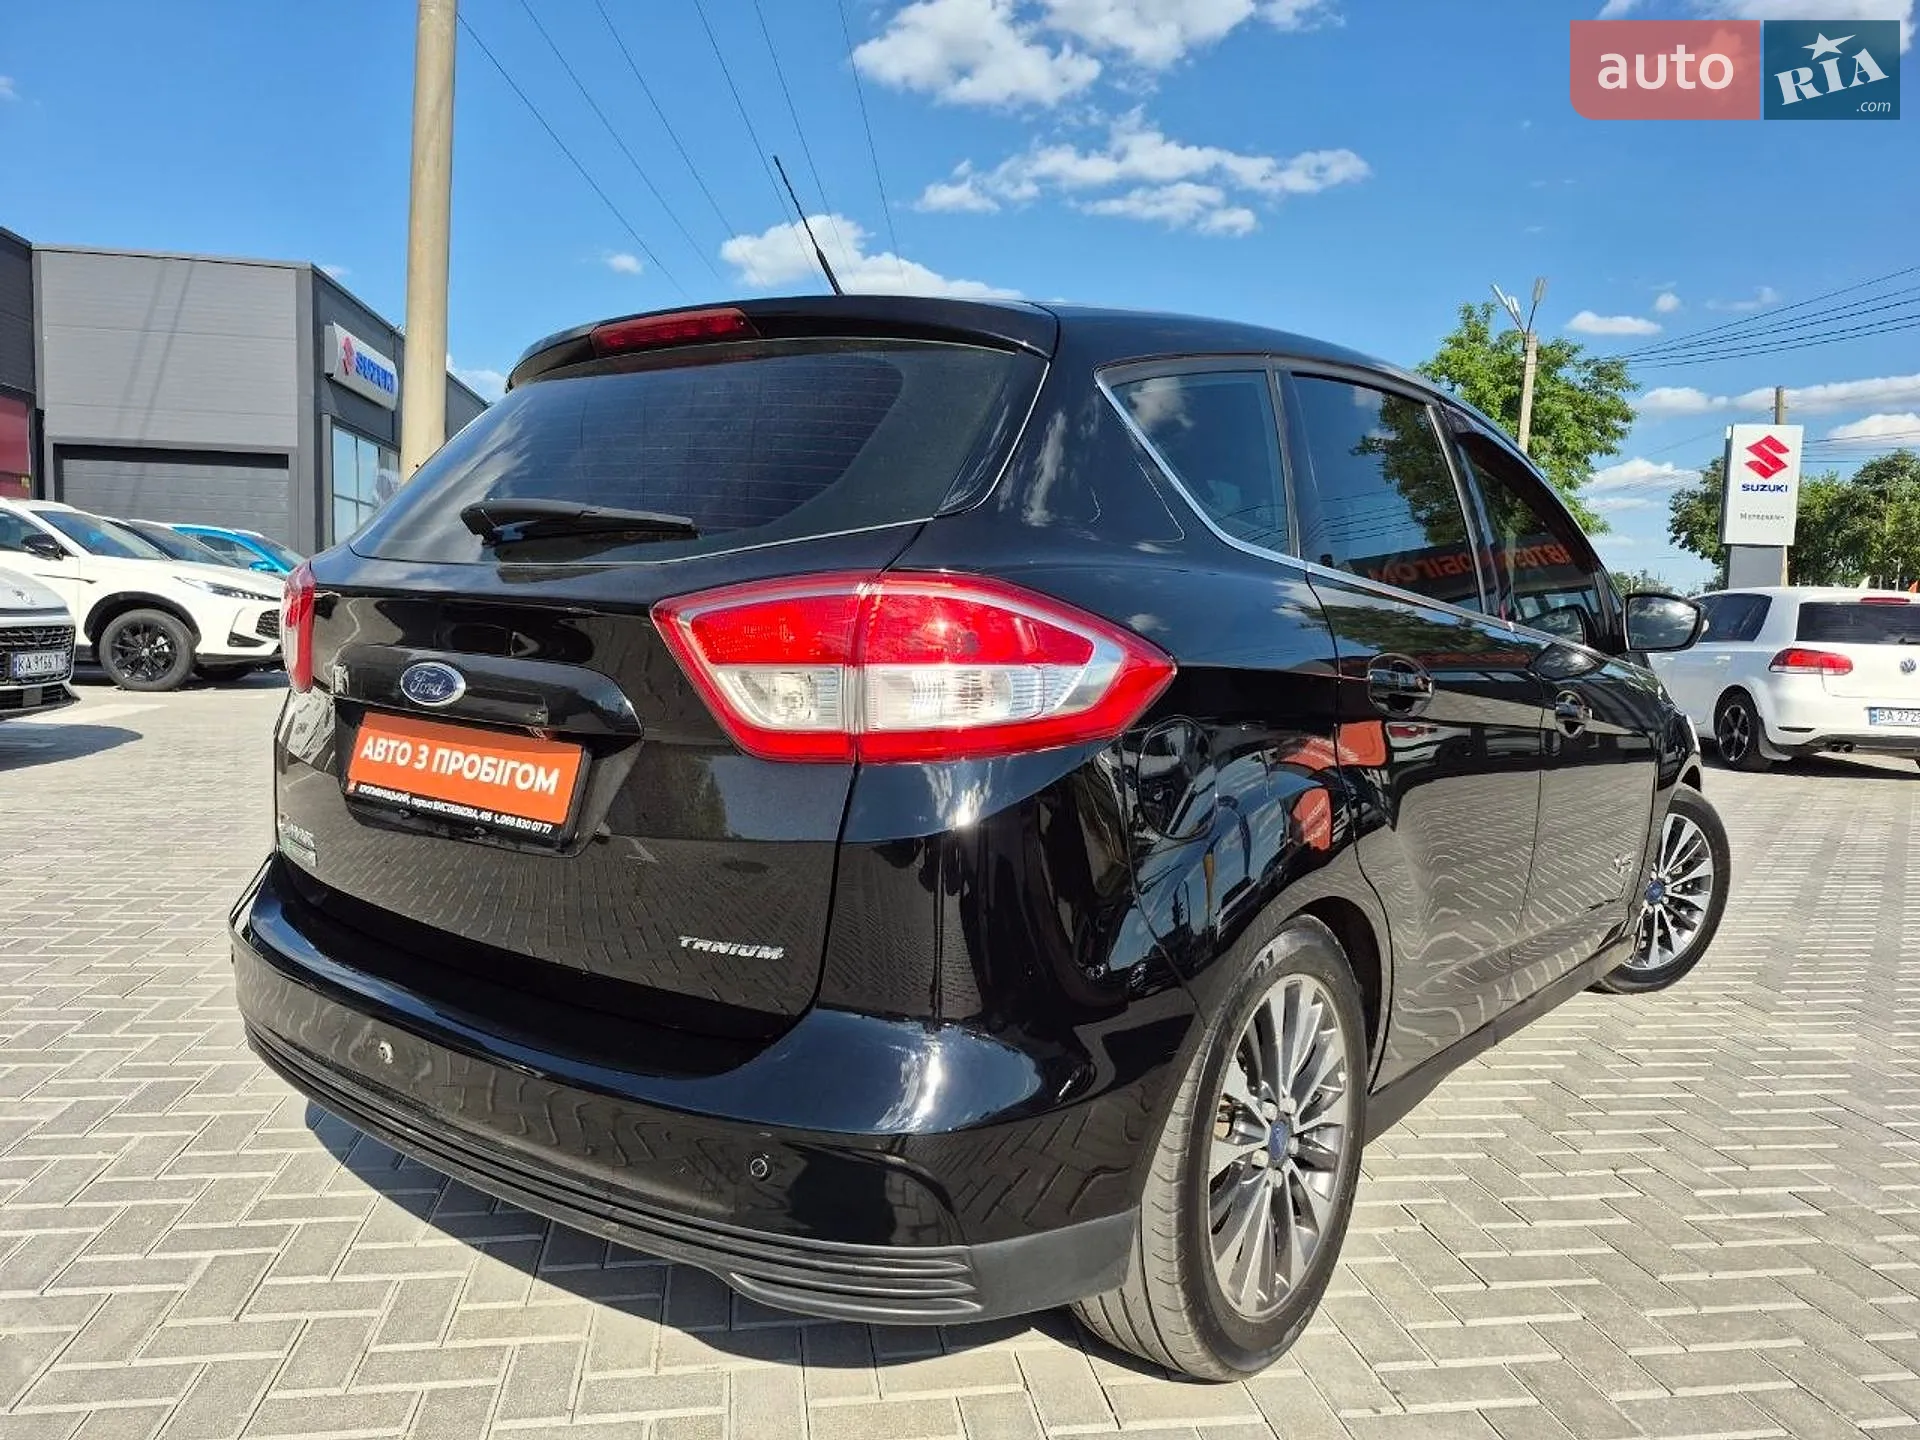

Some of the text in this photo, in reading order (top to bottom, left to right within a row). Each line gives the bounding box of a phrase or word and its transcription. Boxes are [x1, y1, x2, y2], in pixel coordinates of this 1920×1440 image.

[355, 351, 395, 394] SUZUKI
[1741, 484, 1788, 493] SUZUKI
[409, 670, 445, 697] Ford
[360, 736, 412, 767] АВТО
[432, 747, 560, 796] ПРОБІГОМ
